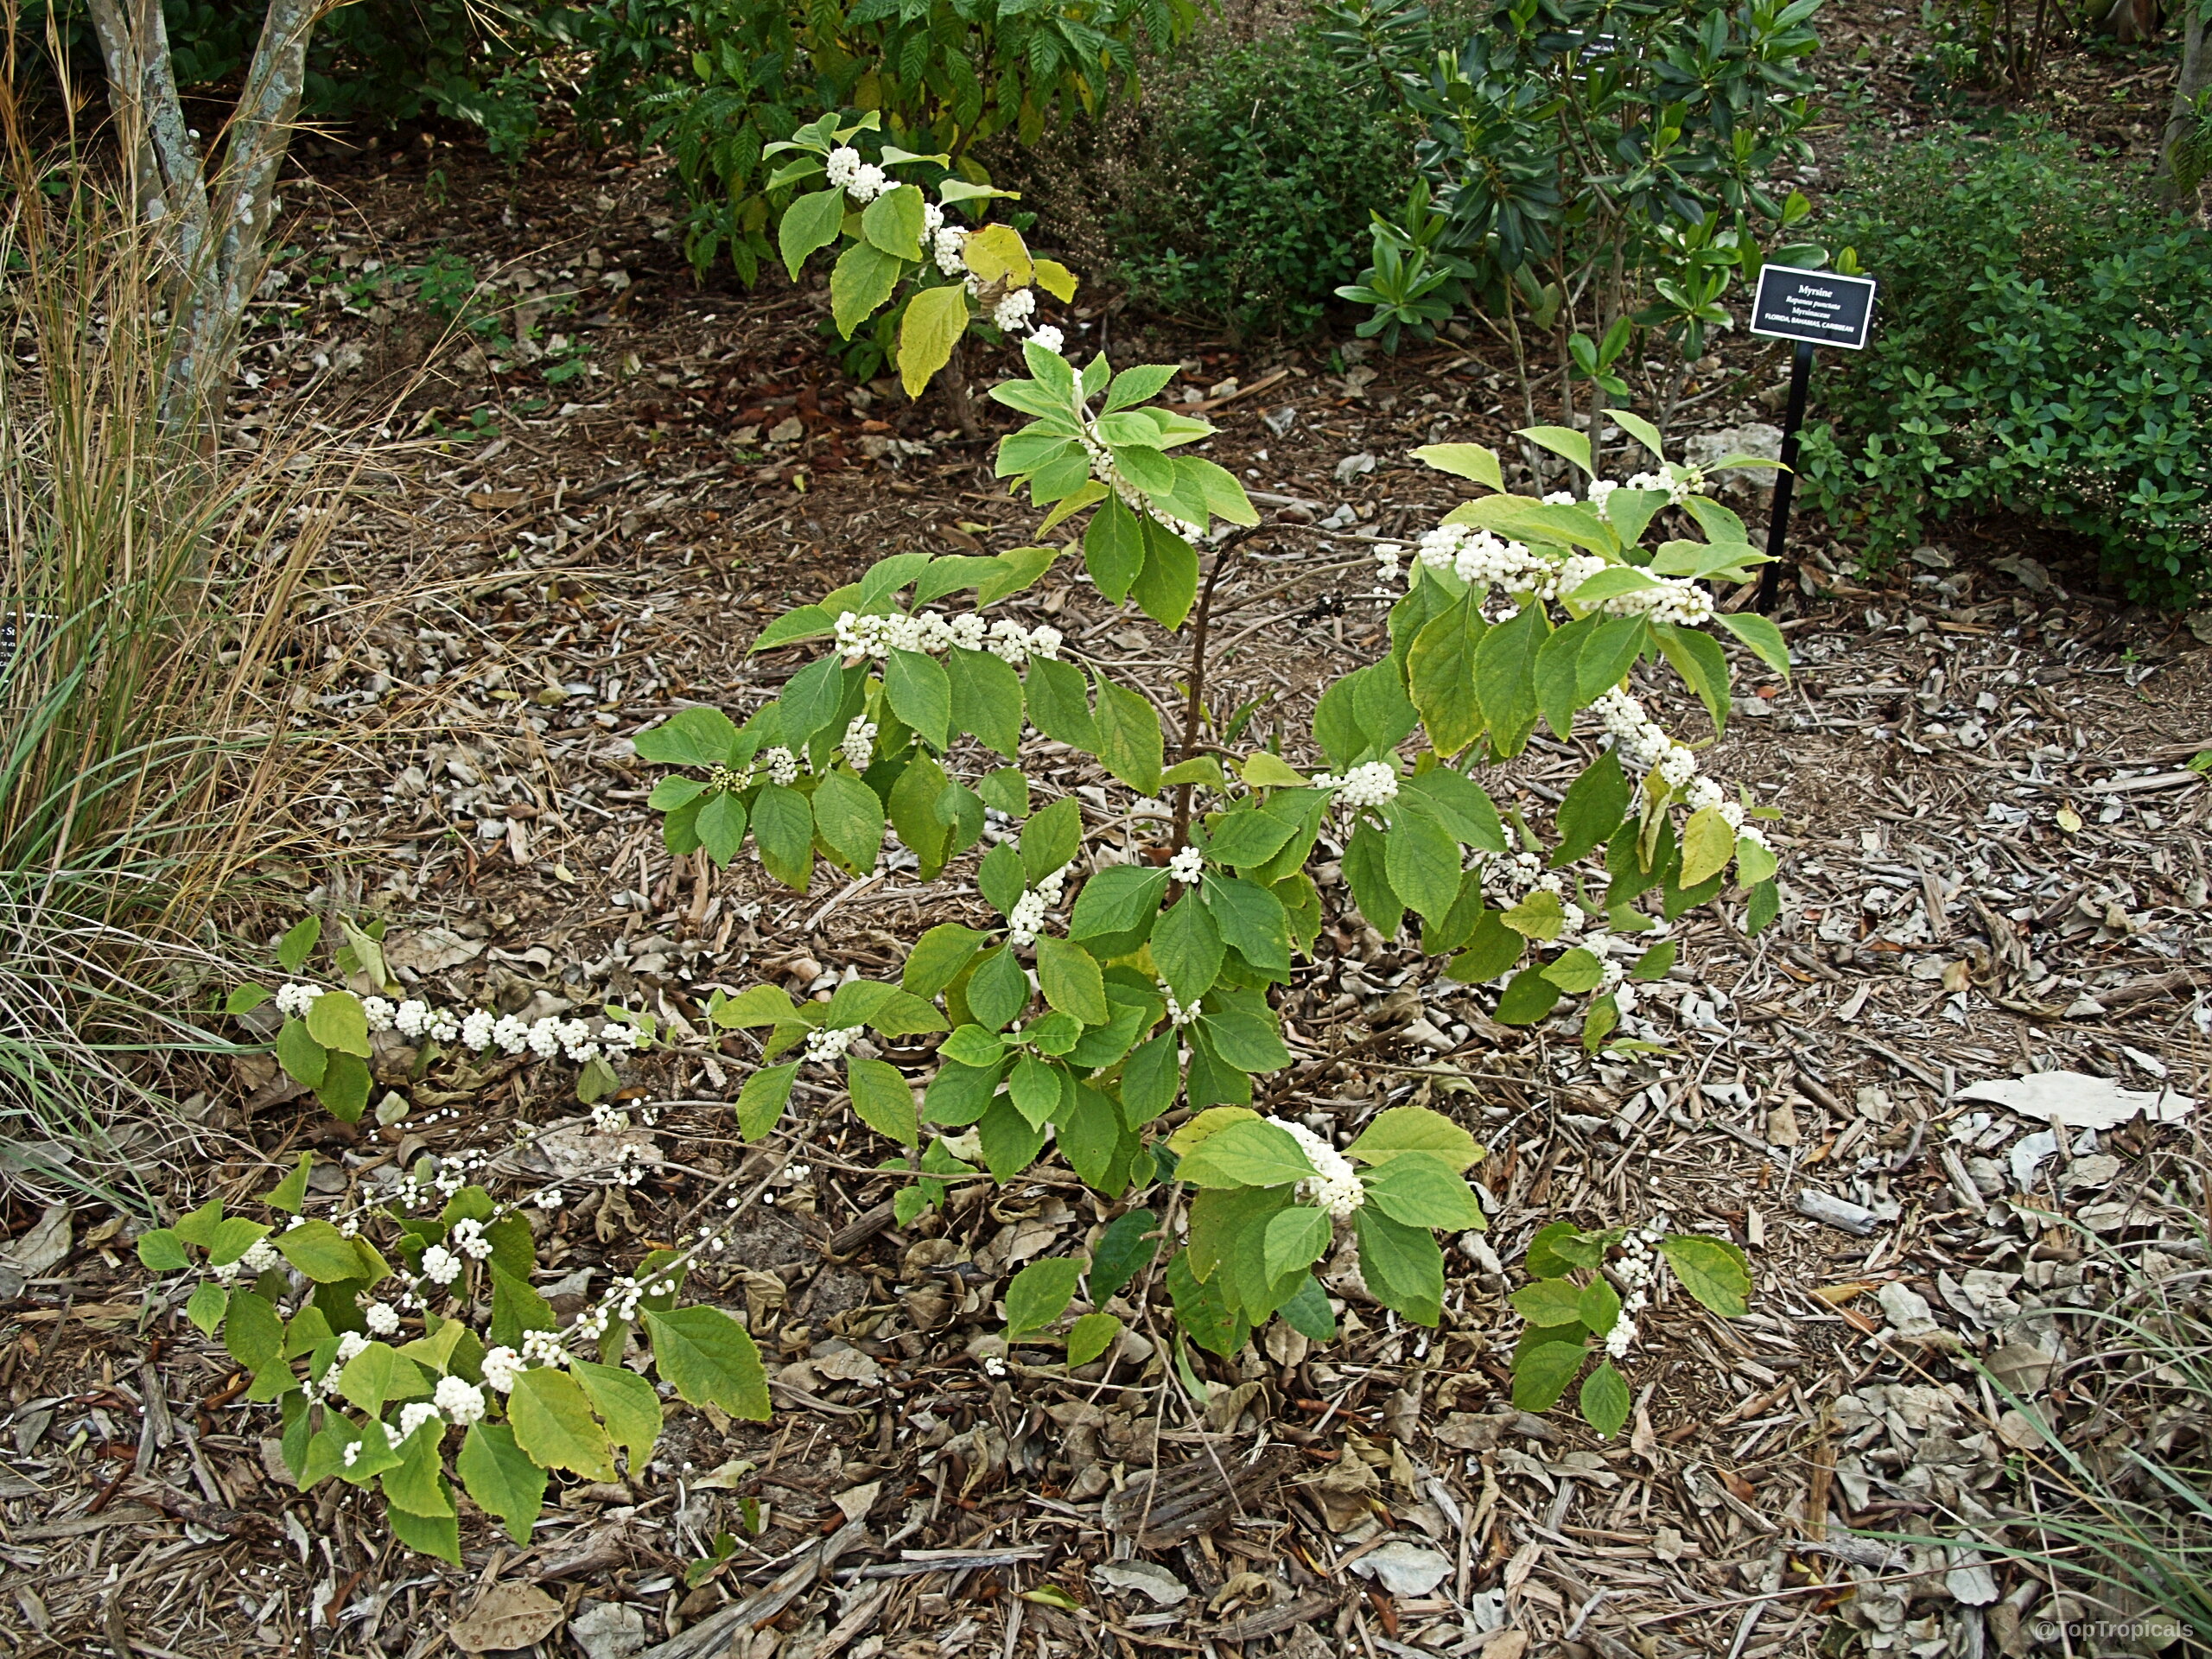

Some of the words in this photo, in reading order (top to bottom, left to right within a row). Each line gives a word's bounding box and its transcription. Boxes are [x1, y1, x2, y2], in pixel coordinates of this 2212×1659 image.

[1798, 284, 1834, 298] Myrsine
[1764, 313, 1790, 323] FLORIDA,
[1790, 316, 1821, 327] BAHAMAS,
[1821, 321, 1855, 333] CARIBBEAN
